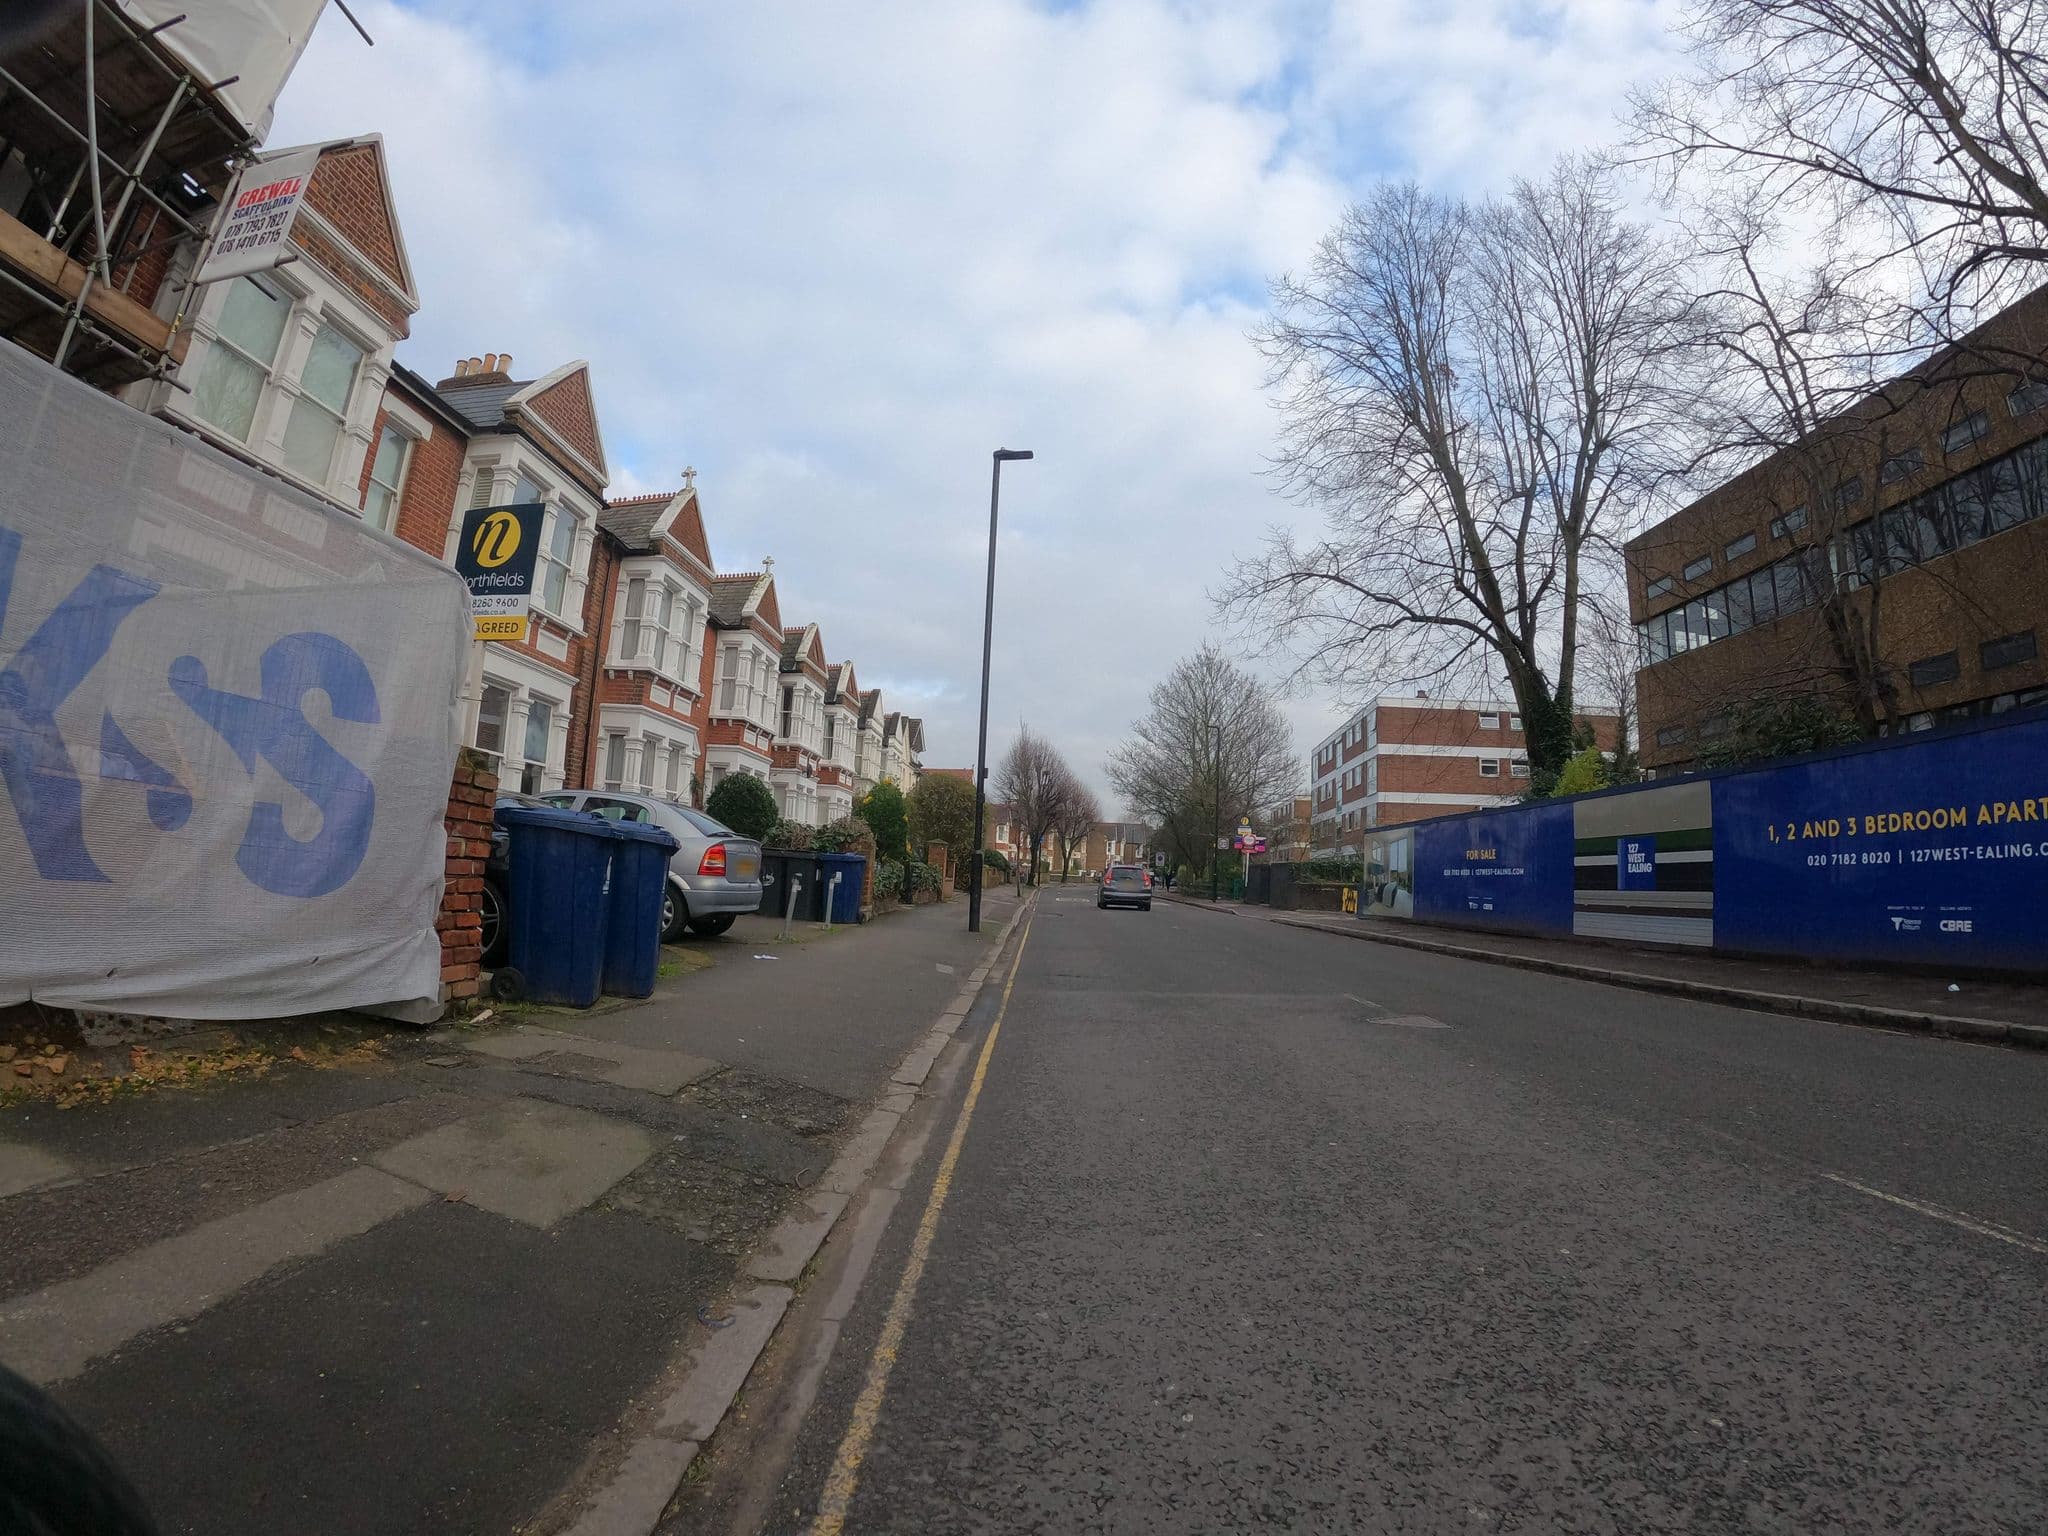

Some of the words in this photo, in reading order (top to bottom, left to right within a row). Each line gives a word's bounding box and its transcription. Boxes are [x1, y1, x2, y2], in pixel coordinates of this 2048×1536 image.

[237, 178, 302, 208] GREWAL
[232, 195, 296, 220] SCAFFOLDING
[464, 571, 525, 588] orthfields
[1787, 823, 1796, 840] 2
[1802, 819, 1840, 839] AND
[1847, 817, 1857, 836] 3
[1865, 806, 1967, 835] BEDROOM
[1977, 797, 2048, 826] APART
[1480, 848, 1496, 860] SALE
[1628, 843, 1639, 853] 127
[1628, 853, 1645, 863] WEST
[1807, 854, 1827, 866] 020
[1831, 853, 1857, 865] 7182
[1861, 851, 1891, 864] 8020
[1628, 863, 1652, 873] EALING
[1940, 919, 1973, 932] CBRE
